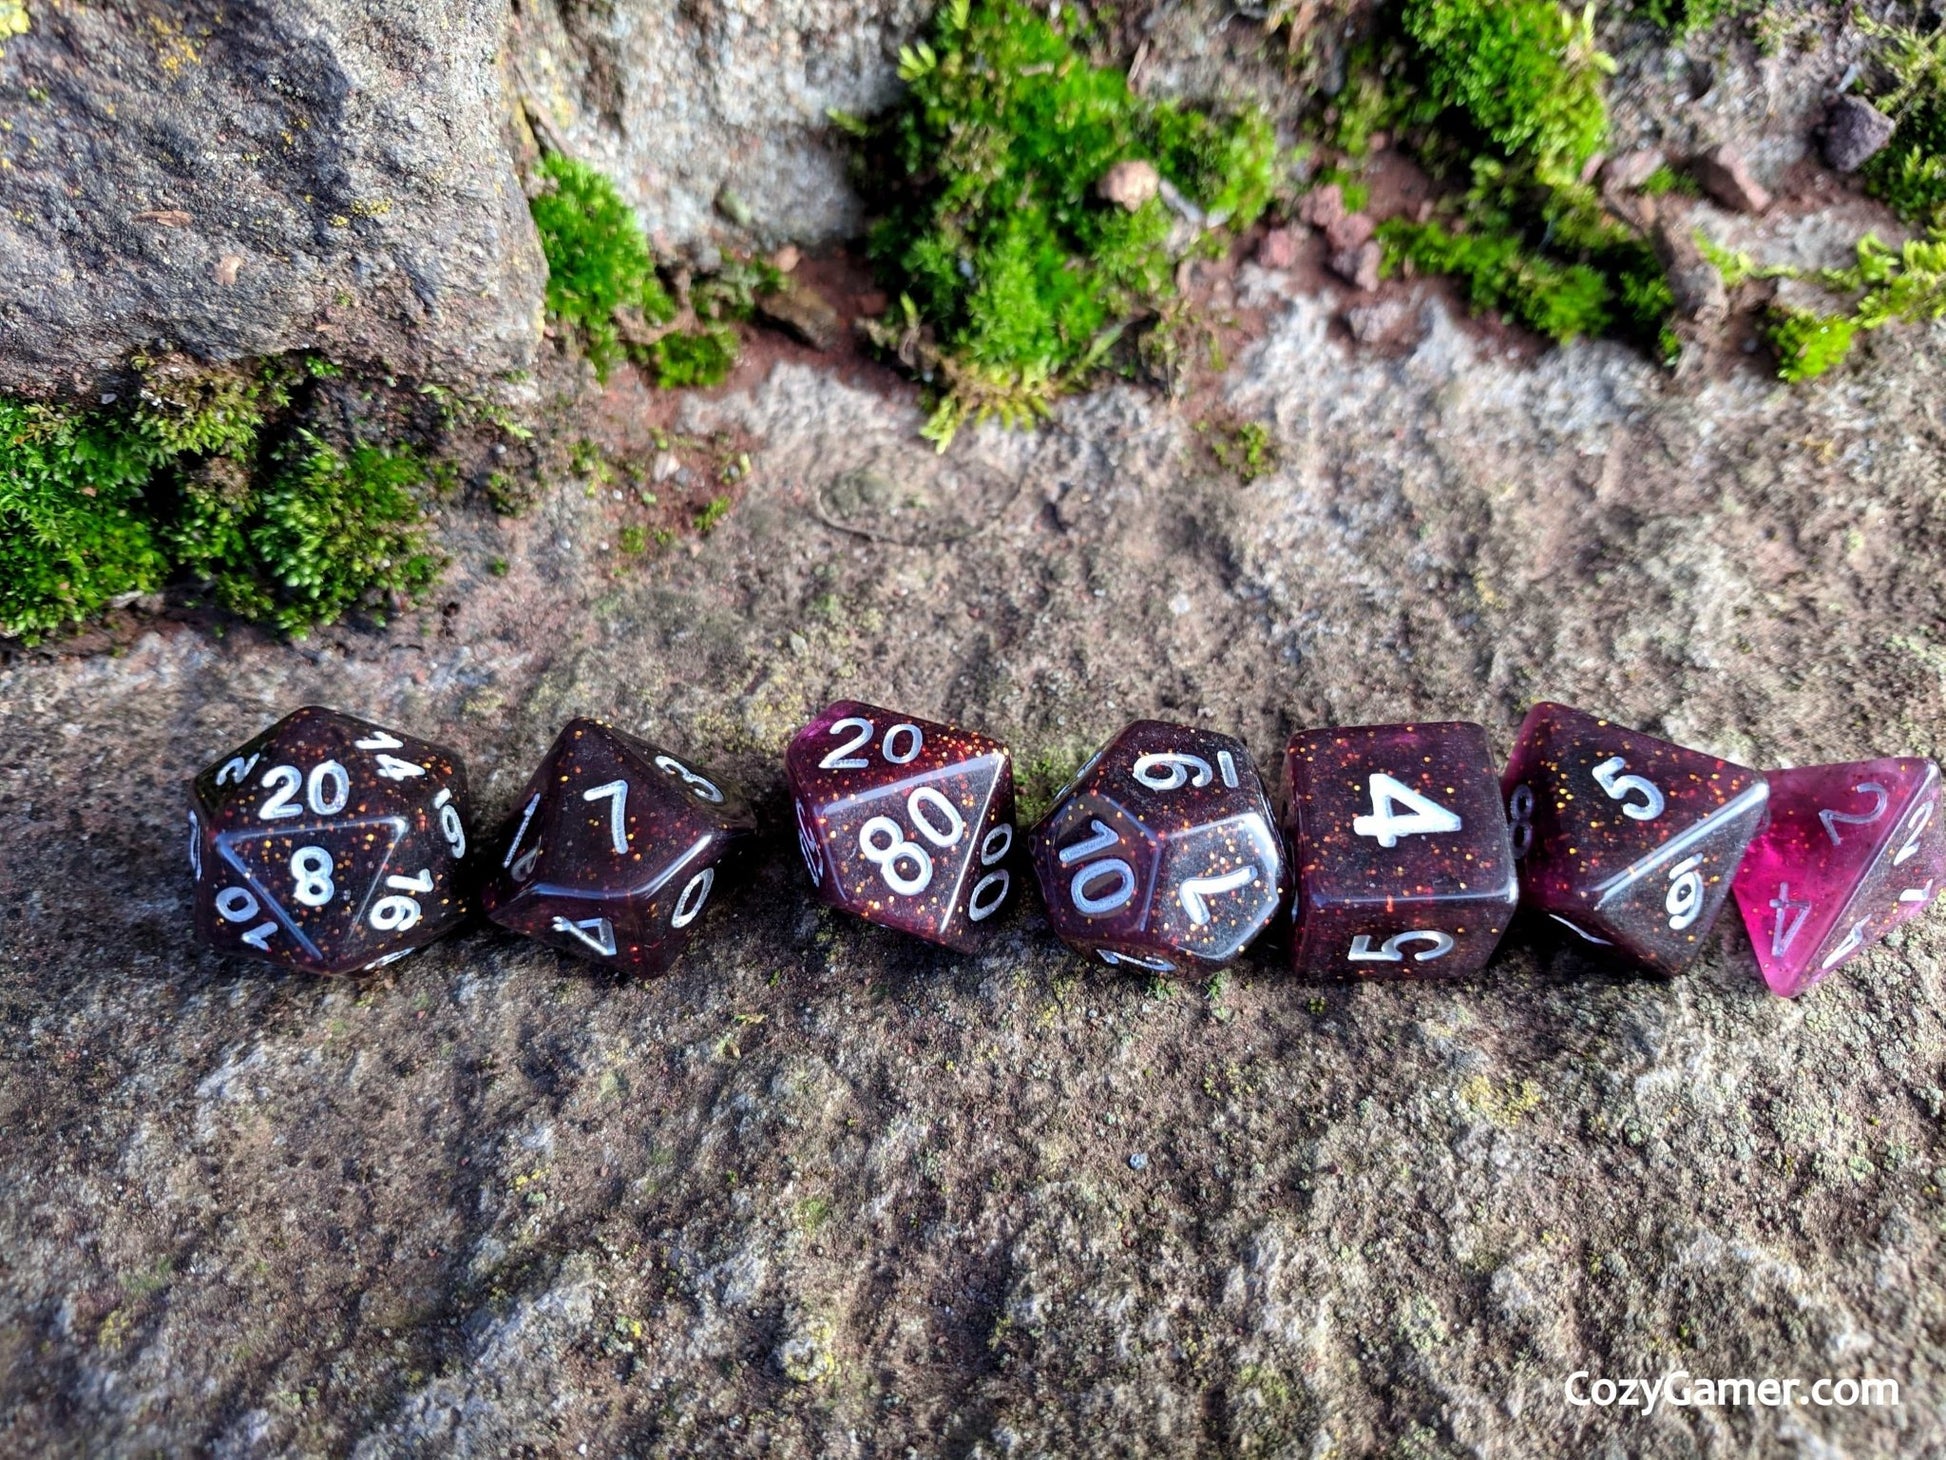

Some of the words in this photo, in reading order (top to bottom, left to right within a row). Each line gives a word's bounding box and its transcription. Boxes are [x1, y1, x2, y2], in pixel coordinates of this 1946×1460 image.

[355, 731, 426, 781] 14
[818, 717, 923, 769] 20
[259, 759, 350, 820] 20
[655, 755, 724, 802] 3
[1353, 773, 1462, 848] 4
[1592, 756, 1665, 821] 5
[583, 779, 629, 854] 7
[860, 786, 964, 896] 80
[1508, 784, 1534, 860] 8
[1818, 782, 1888, 846] 2
[1893, 800, 1935, 866] 2
[290, 845, 335, 906] 8
[671, 867, 714, 928] 0
[968, 823, 1013, 922] 00
[1059, 819, 1135, 915] 10
[1179, 865, 1258, 926] 7
[215, 886, 278, 951] 10
[370, 869, 434, 931] 16
[1769, 882, 1812, 957] 4
[552, 916, 617, 956] 4
[1347, 929, 1454, 961] 5
